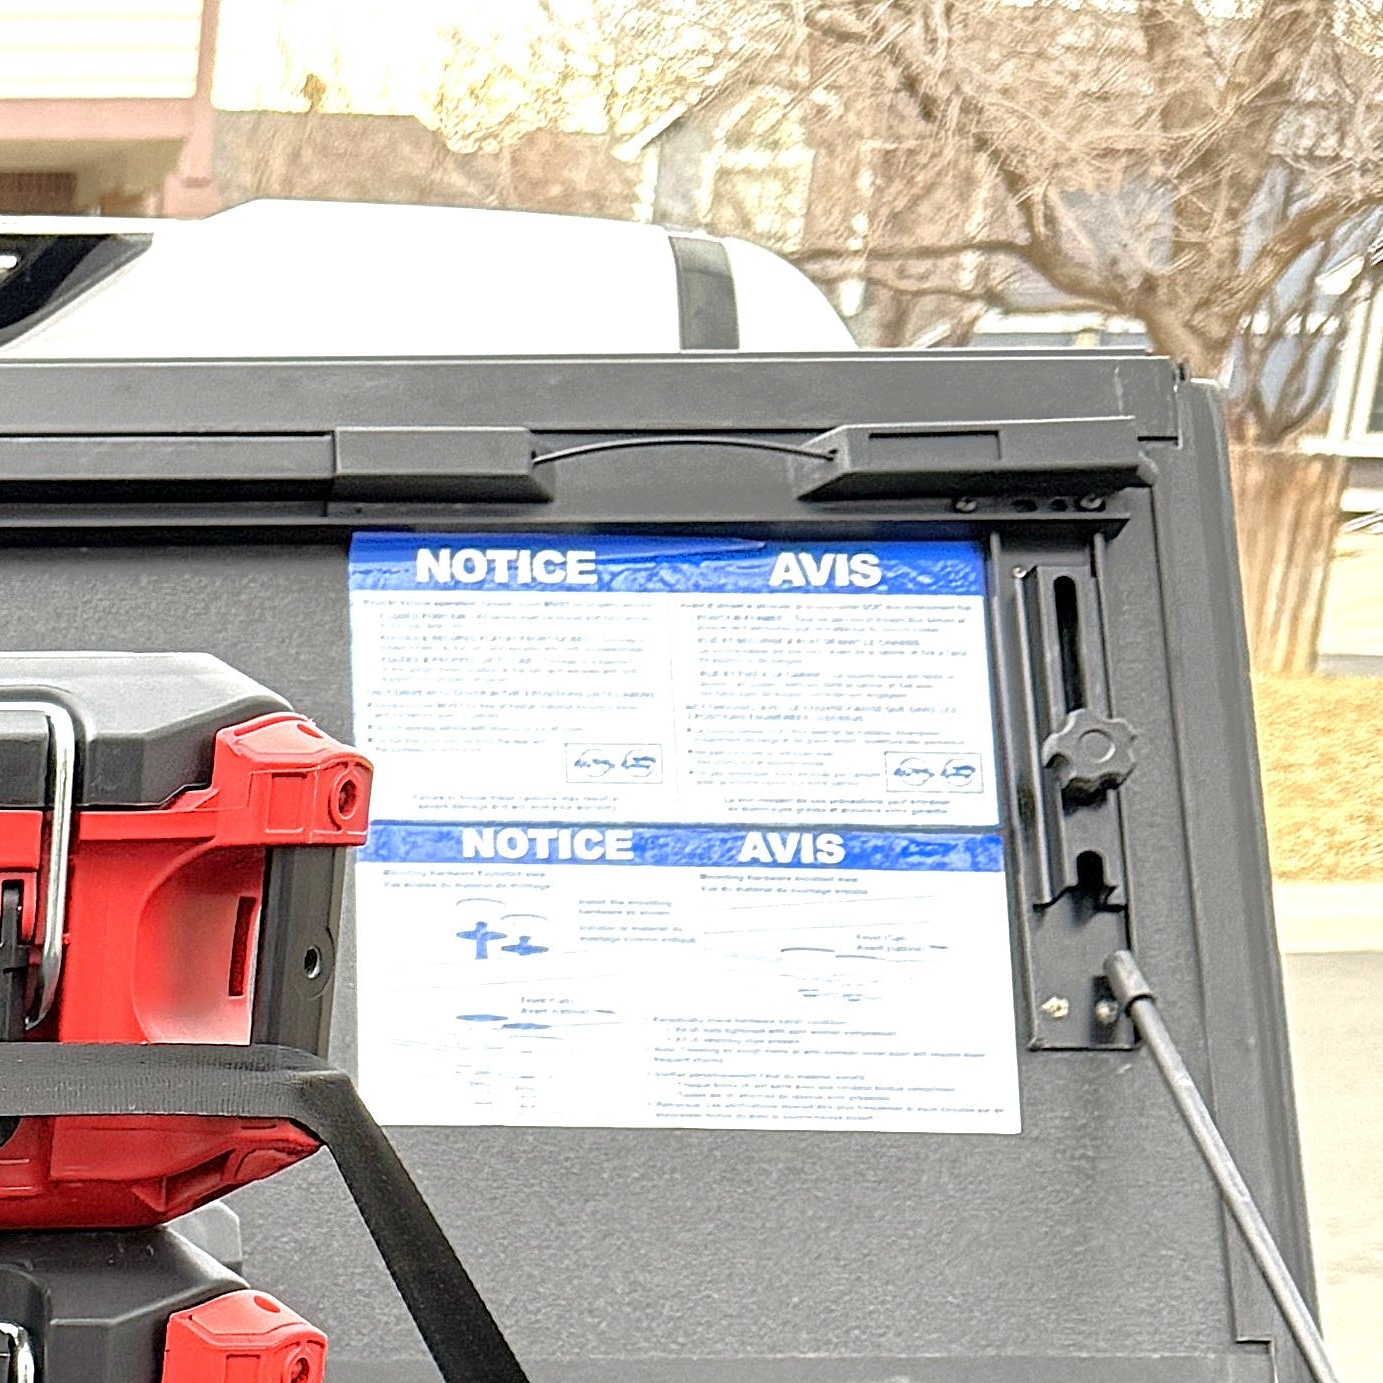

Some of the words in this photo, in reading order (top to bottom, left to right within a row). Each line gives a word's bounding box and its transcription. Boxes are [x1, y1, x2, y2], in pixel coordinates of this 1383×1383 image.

[414, 547, 599, 585] NOTICE
[768, 551, 883, 588] AVIS
[461, 826, 635, 862] NOTICE
[737, 831, 846, 865] AVIS
